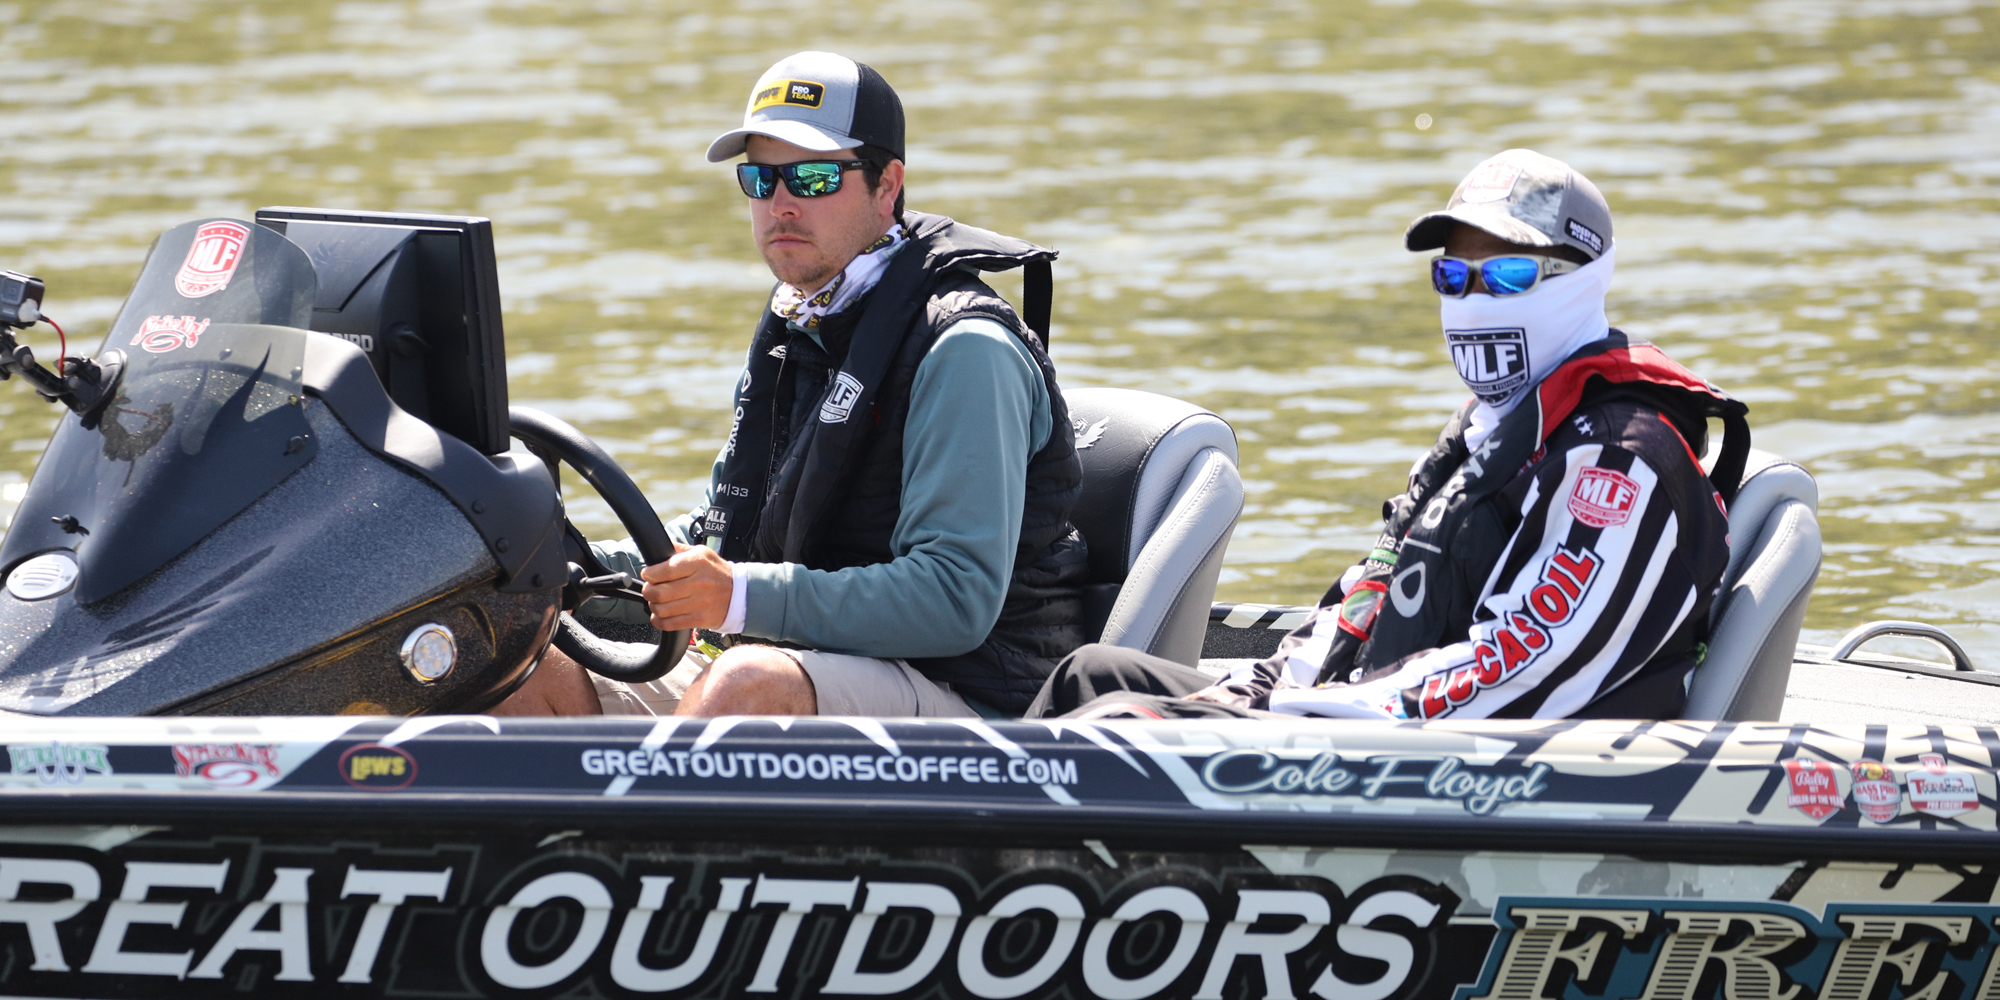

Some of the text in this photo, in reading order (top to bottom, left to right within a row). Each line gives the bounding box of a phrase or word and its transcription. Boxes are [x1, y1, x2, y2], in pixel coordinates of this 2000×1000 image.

[791, 92, 815, 101] TEAM
[792, 86, 810, 94] PRO
[187, 236, 238, 272] MLF
[1454, 343, 1518, 382] MLF
[1576, 478, 1631, 511] MLF
[704, 521, 725, 532] CLEAR
[706, 510, 727, 523] ALL
[1421, 545, 1602, 719] LUCAS OIL
[581, 748, 1078, 785] GREATOUTDOORSCOFFEE.COM
[1203, 748, 1554, 816] Cole Floyd
[1795, 770, 1829, 789] Bally
[1856, 784, 1898, 796] BASS PRO
[480, 871, 1442, 1000] OUTDOORS
[1469, 907, 2000, 1000] FRE
